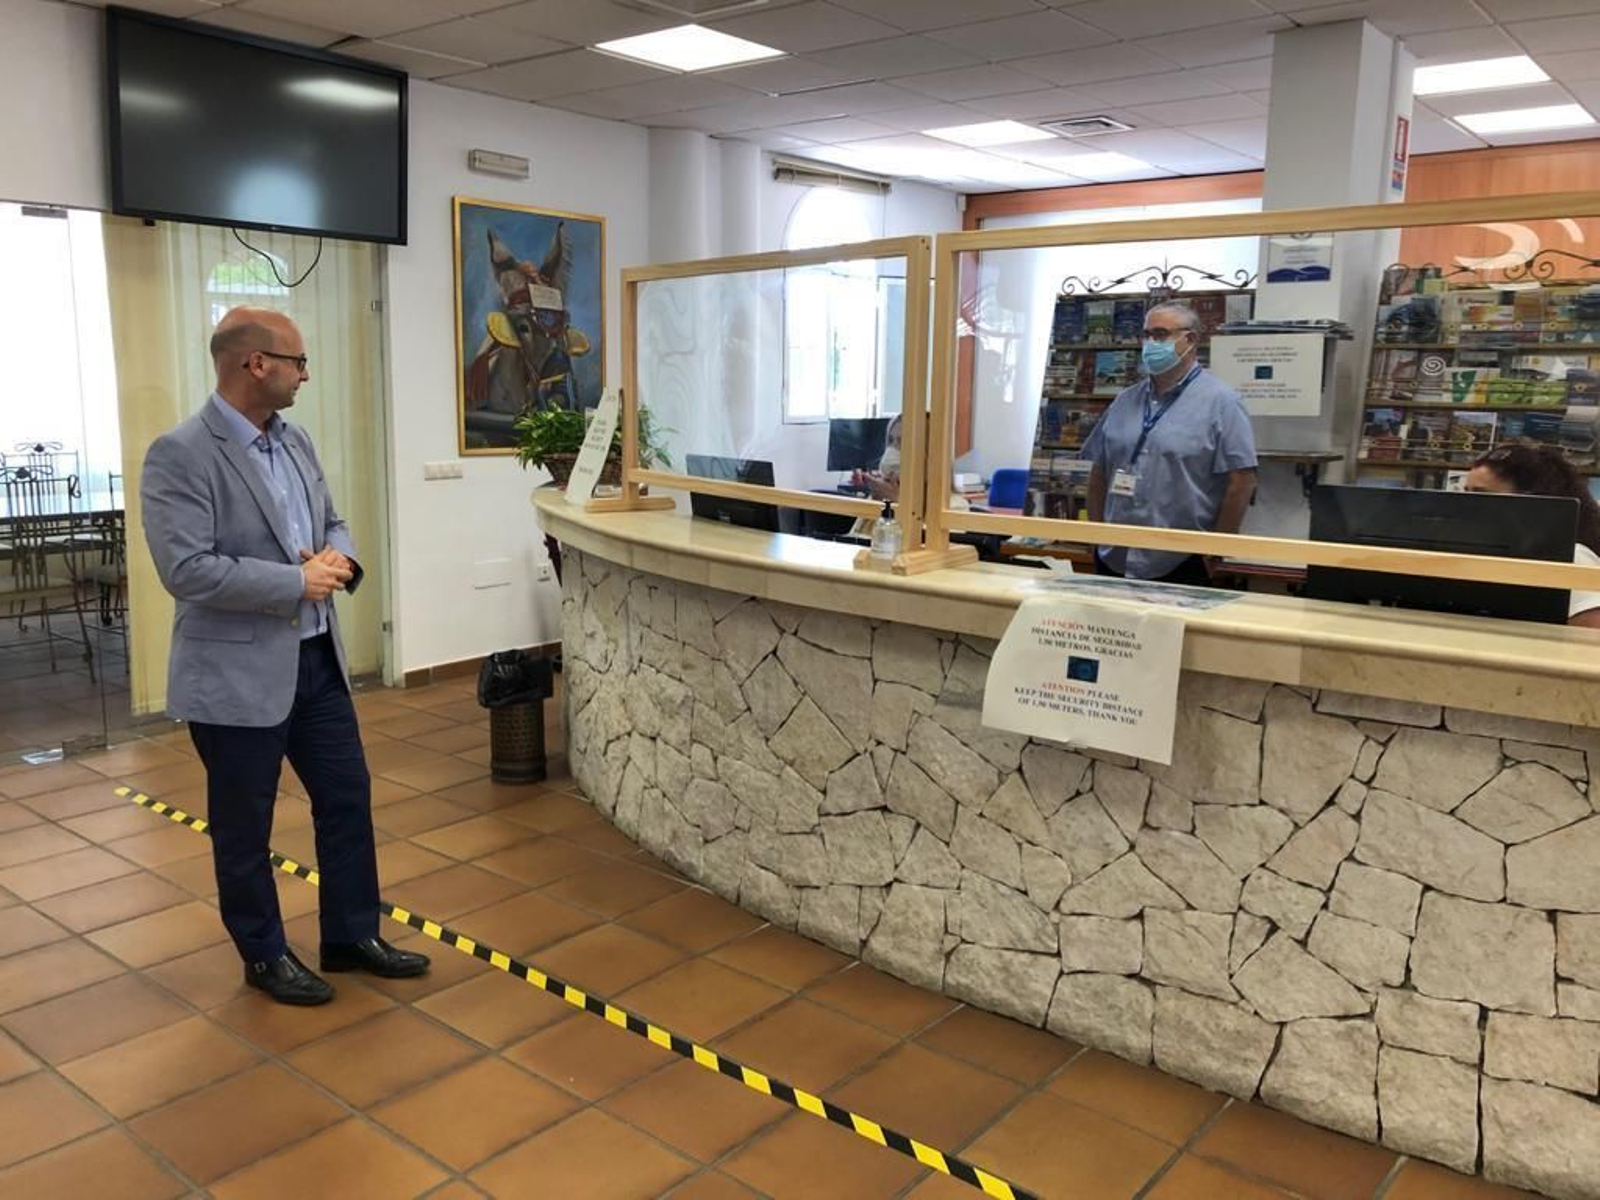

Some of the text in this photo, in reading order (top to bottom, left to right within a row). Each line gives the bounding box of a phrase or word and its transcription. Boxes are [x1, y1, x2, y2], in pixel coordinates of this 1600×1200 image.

[1032, 626, 1142, 651] DISTANCIA DE SEGURIDAD
[1087, 624, 1136, 640] MANTENGA
[1095, 646, 1134, 659] GRACIAS
[1014, 686, 1144, 717] KEEP THE SECURITY DISTANCE
[1087, 689, 1120, 702] PLEASE
[1017, 696, 1030, 706] OF
[1087, 709, 1119, 722] THANK
[1120, 716, 1138, 727] YOU
